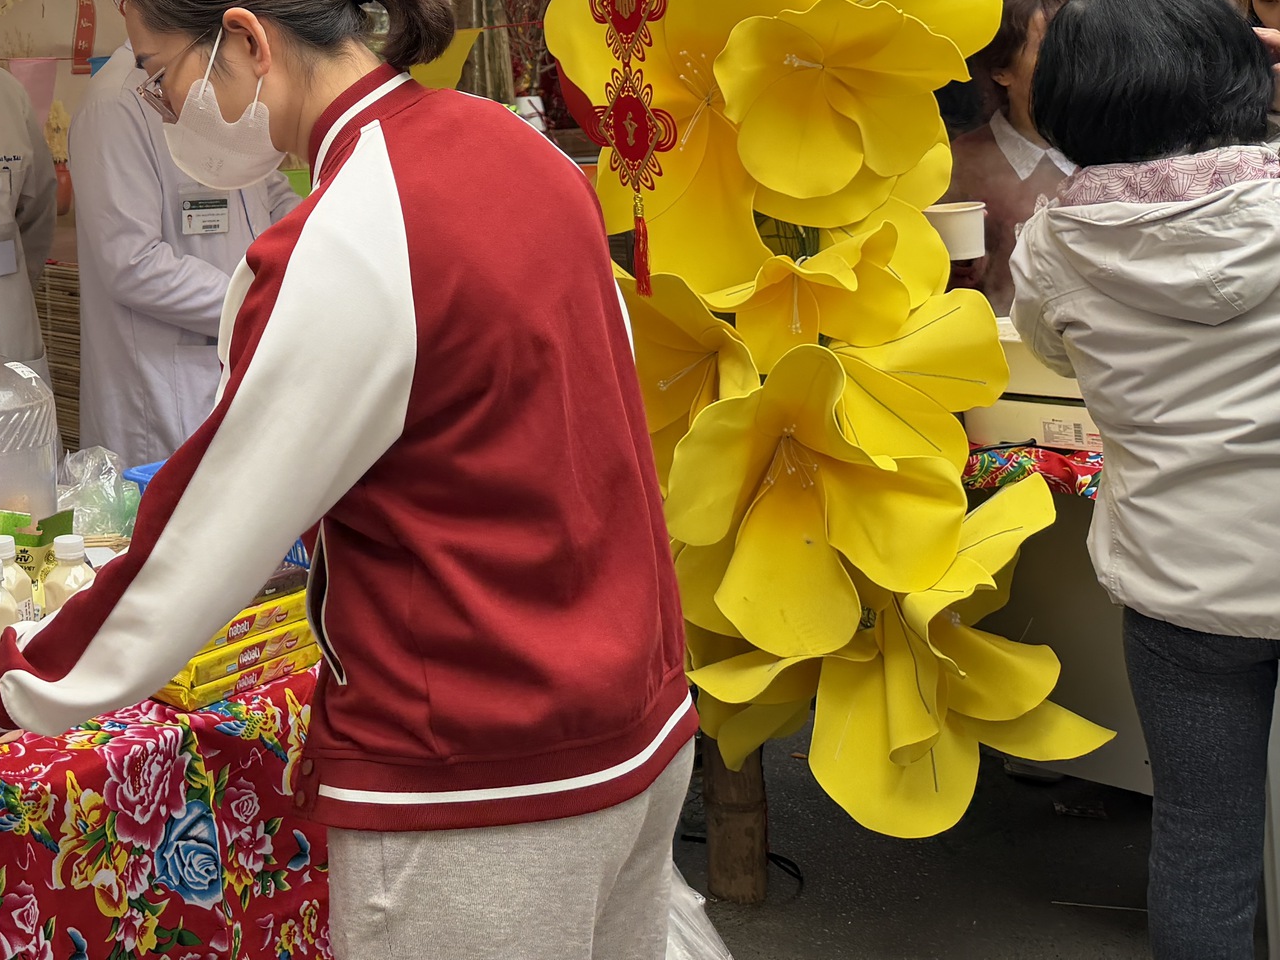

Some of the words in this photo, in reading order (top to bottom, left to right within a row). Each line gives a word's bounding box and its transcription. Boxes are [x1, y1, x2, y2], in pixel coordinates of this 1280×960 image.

[228, 620, 249, 638] nabati
[240, 647, 260, 665] nabati
[237, 672, 257, 690] nabati
